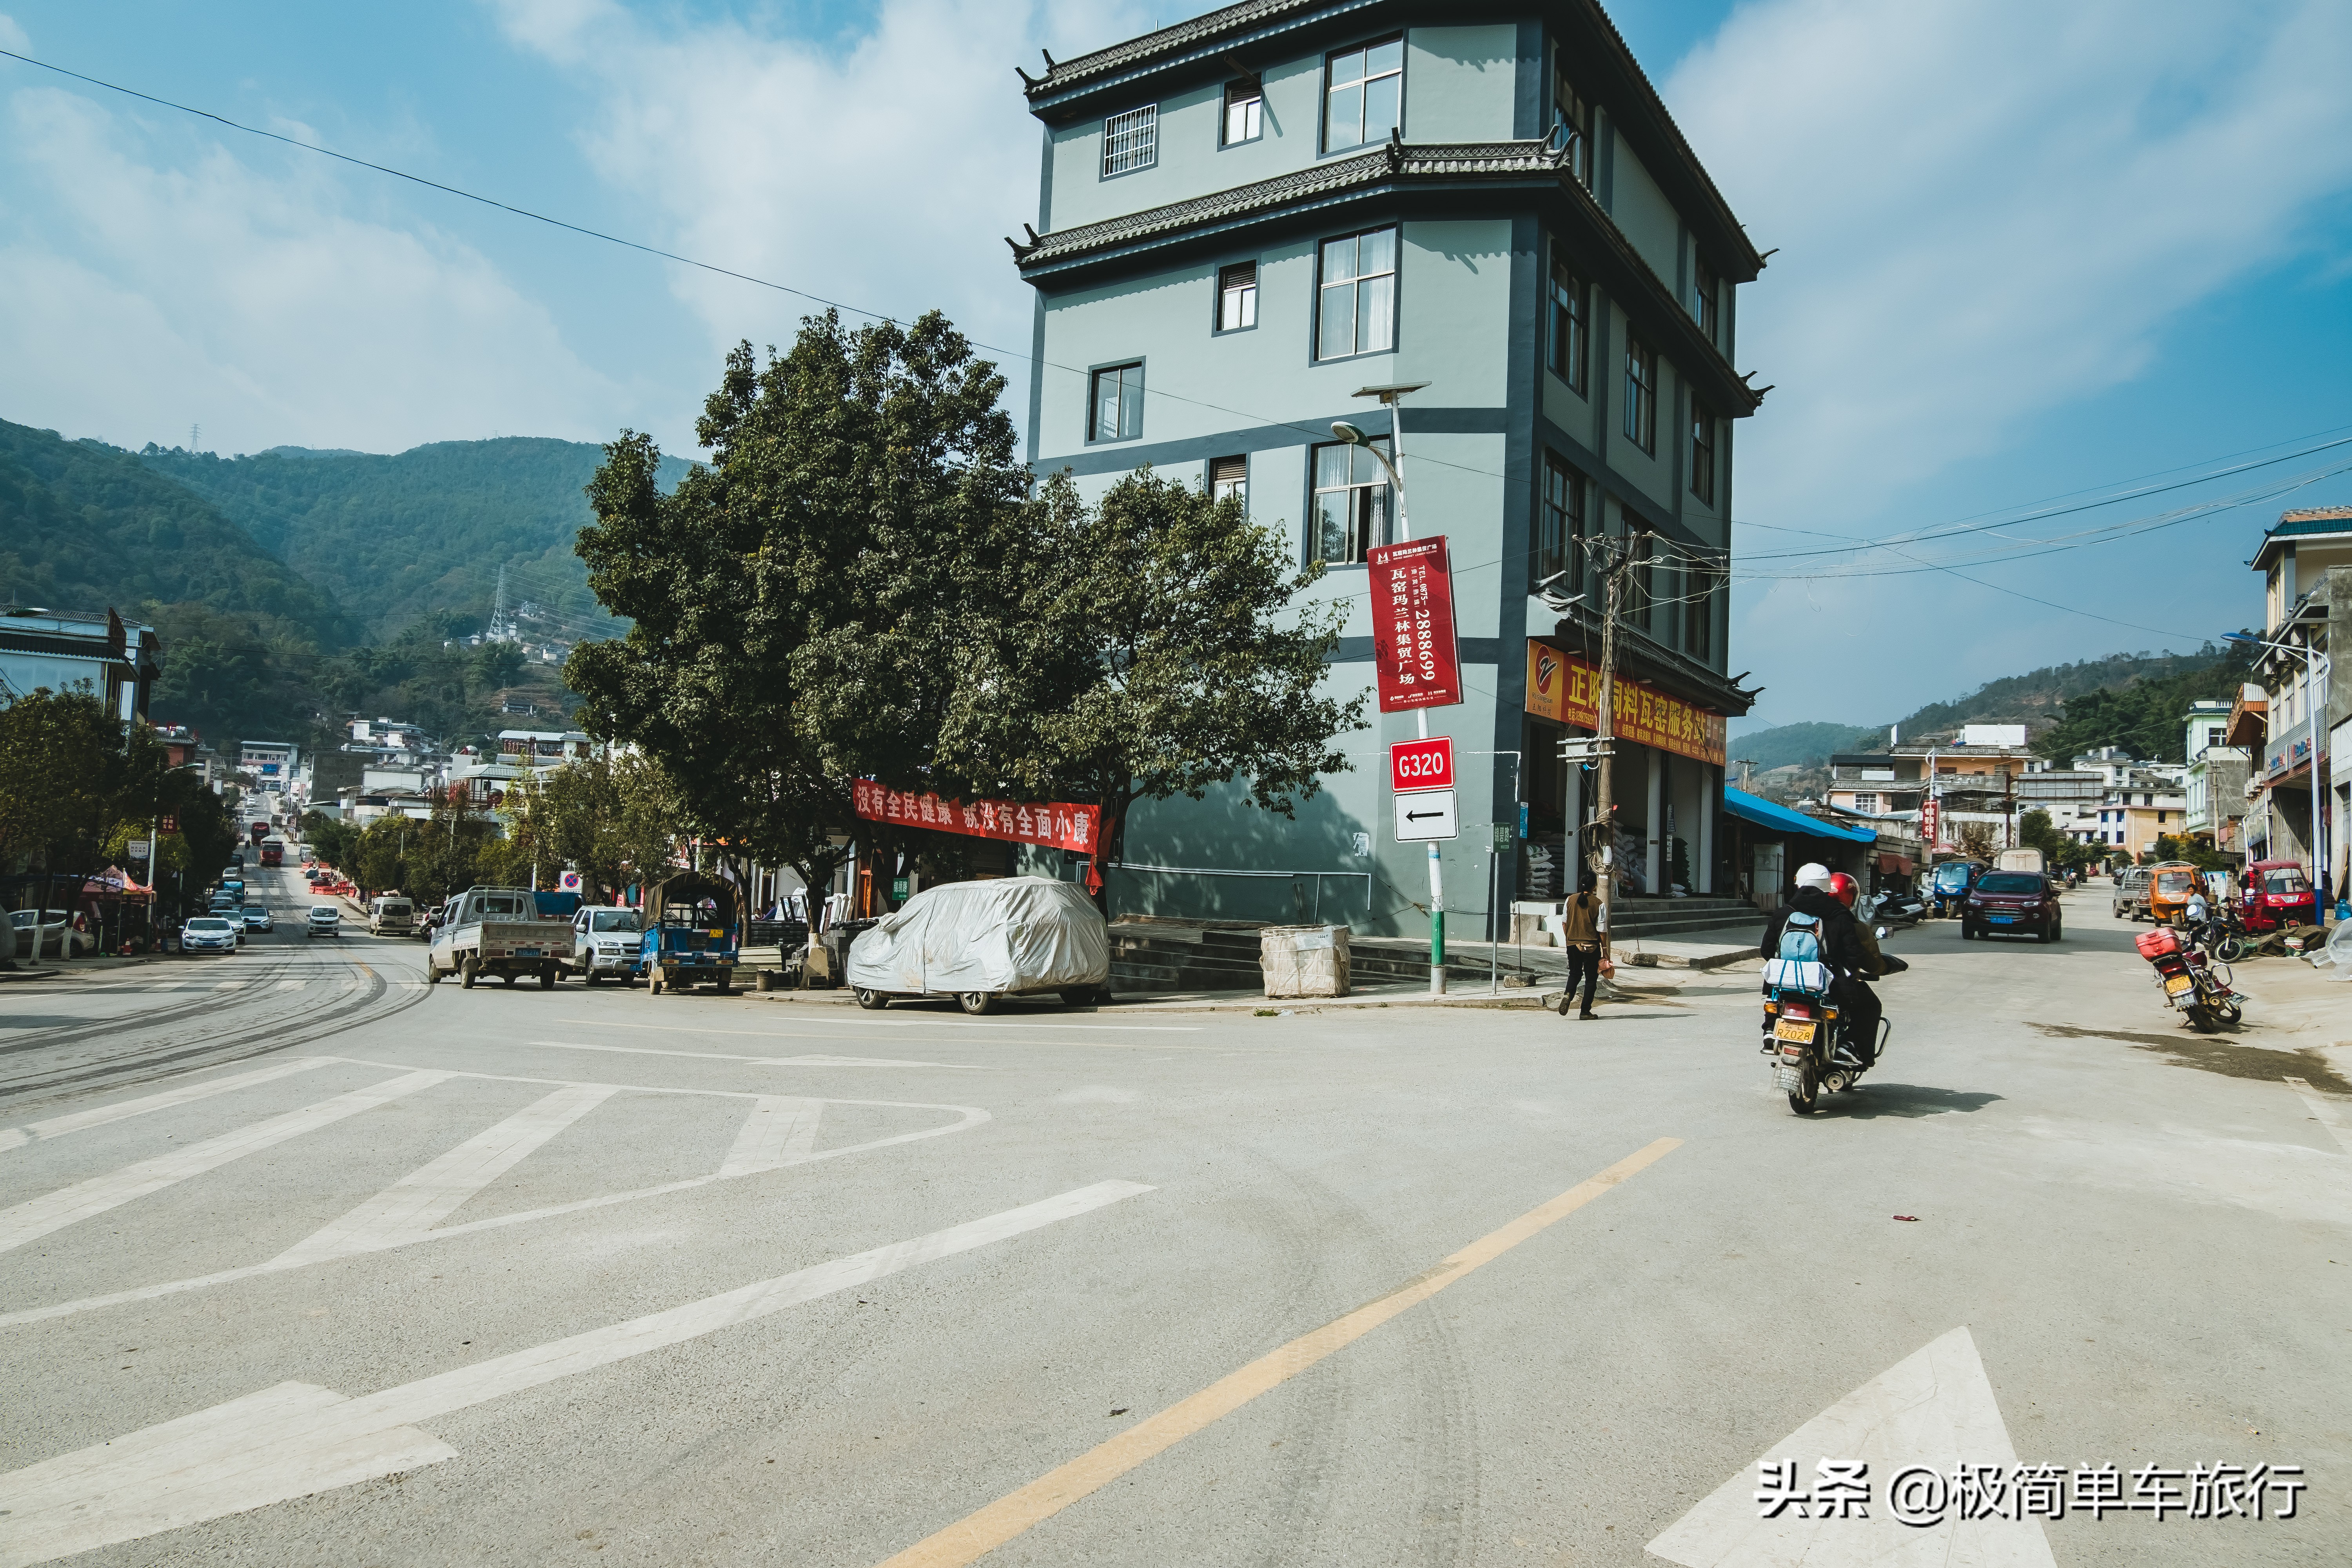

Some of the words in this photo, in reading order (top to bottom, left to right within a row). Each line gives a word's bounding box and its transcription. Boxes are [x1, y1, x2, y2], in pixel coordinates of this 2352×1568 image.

[1390, 567, 1415, 685] 瓦窑玛兰林集贸广场
[1416, 609, 1435, 681] 2888699
[1532, 691, 1553, 704] Risingsun
[1399, 753, 1444, 778] G320
[857, 785, 953, 824] 没有全民健康
[963, 801, 1089, 844] 就没有全面小康
[1777, 1029, 1810, 1040] RZ028
